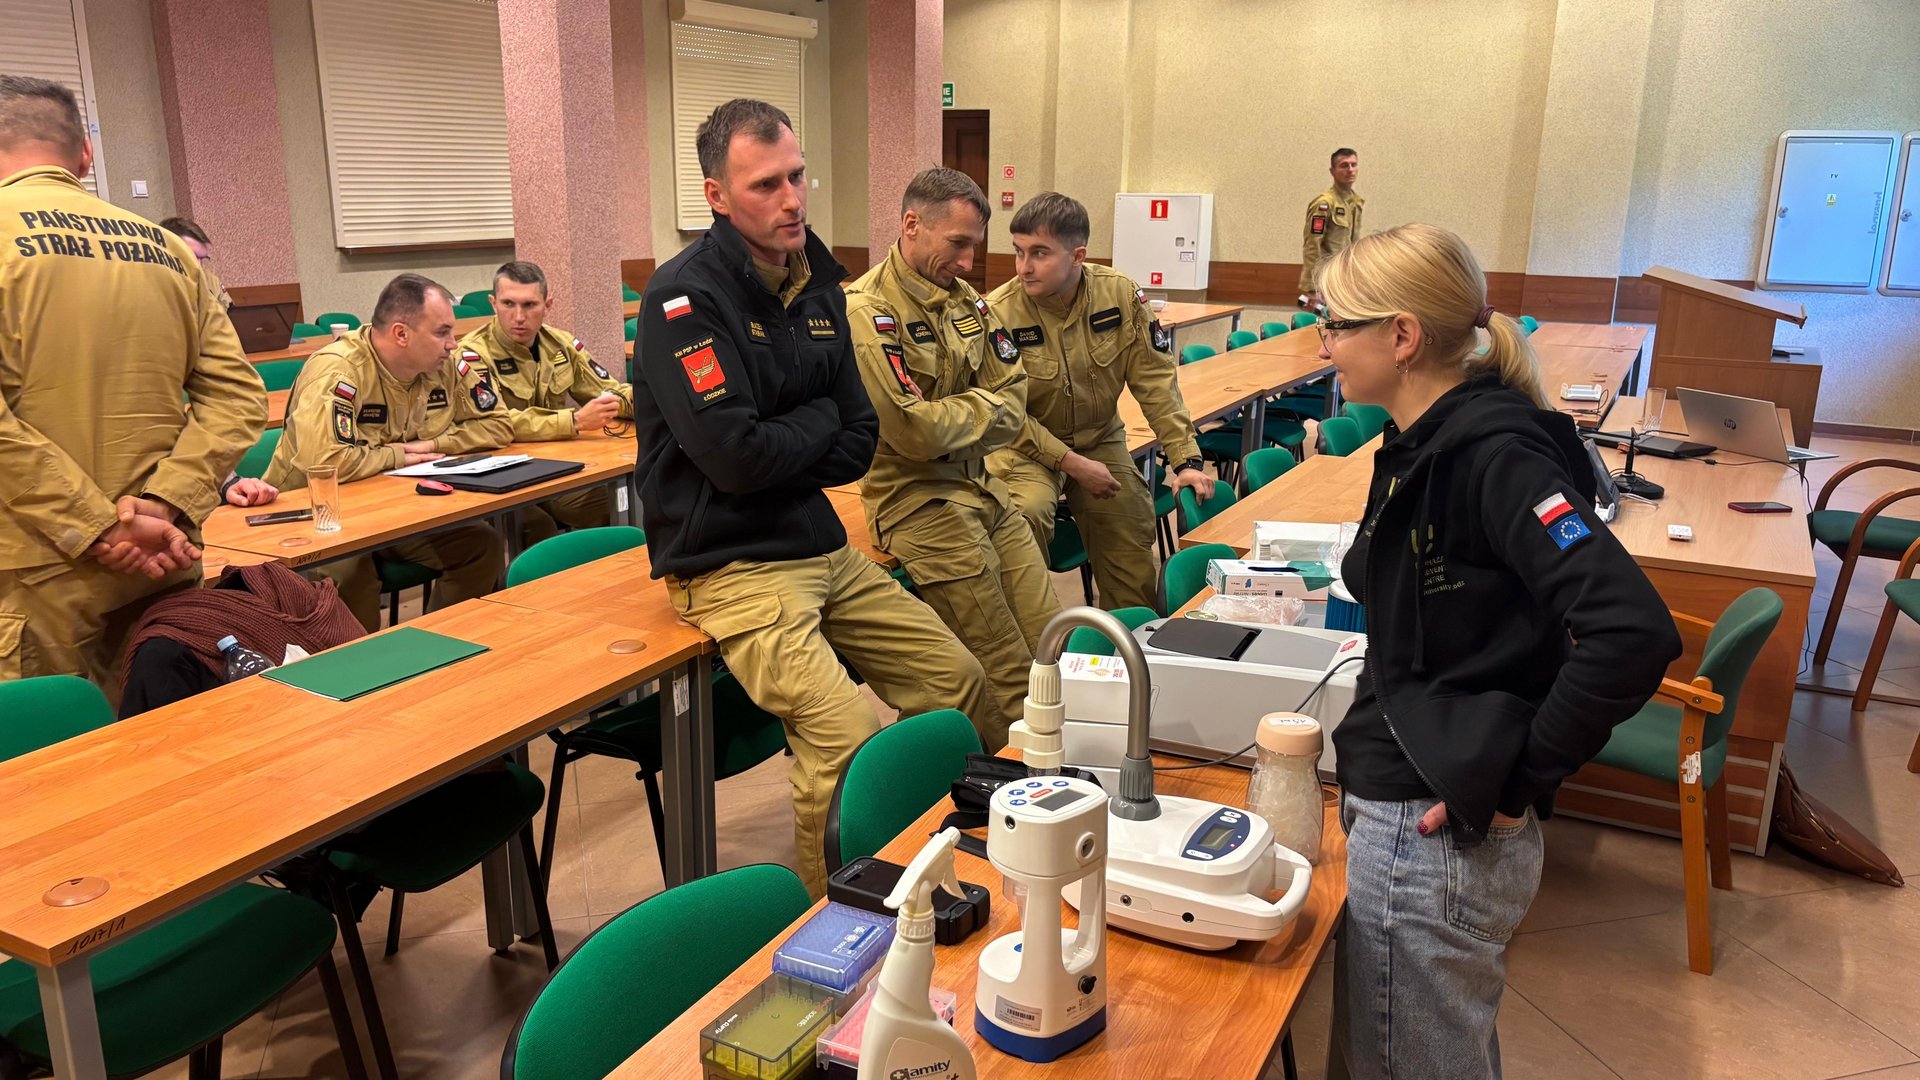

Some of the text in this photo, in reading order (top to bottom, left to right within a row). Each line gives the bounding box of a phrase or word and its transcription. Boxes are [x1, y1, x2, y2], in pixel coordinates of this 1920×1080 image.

[19, 209, 167, 248] PAŃSTWOWA
[15, 233, 188, 276] STRAŻ POŻARNA
[683, 346, 693, 354] PSP
[910, 1059, 951, 1077] amity
